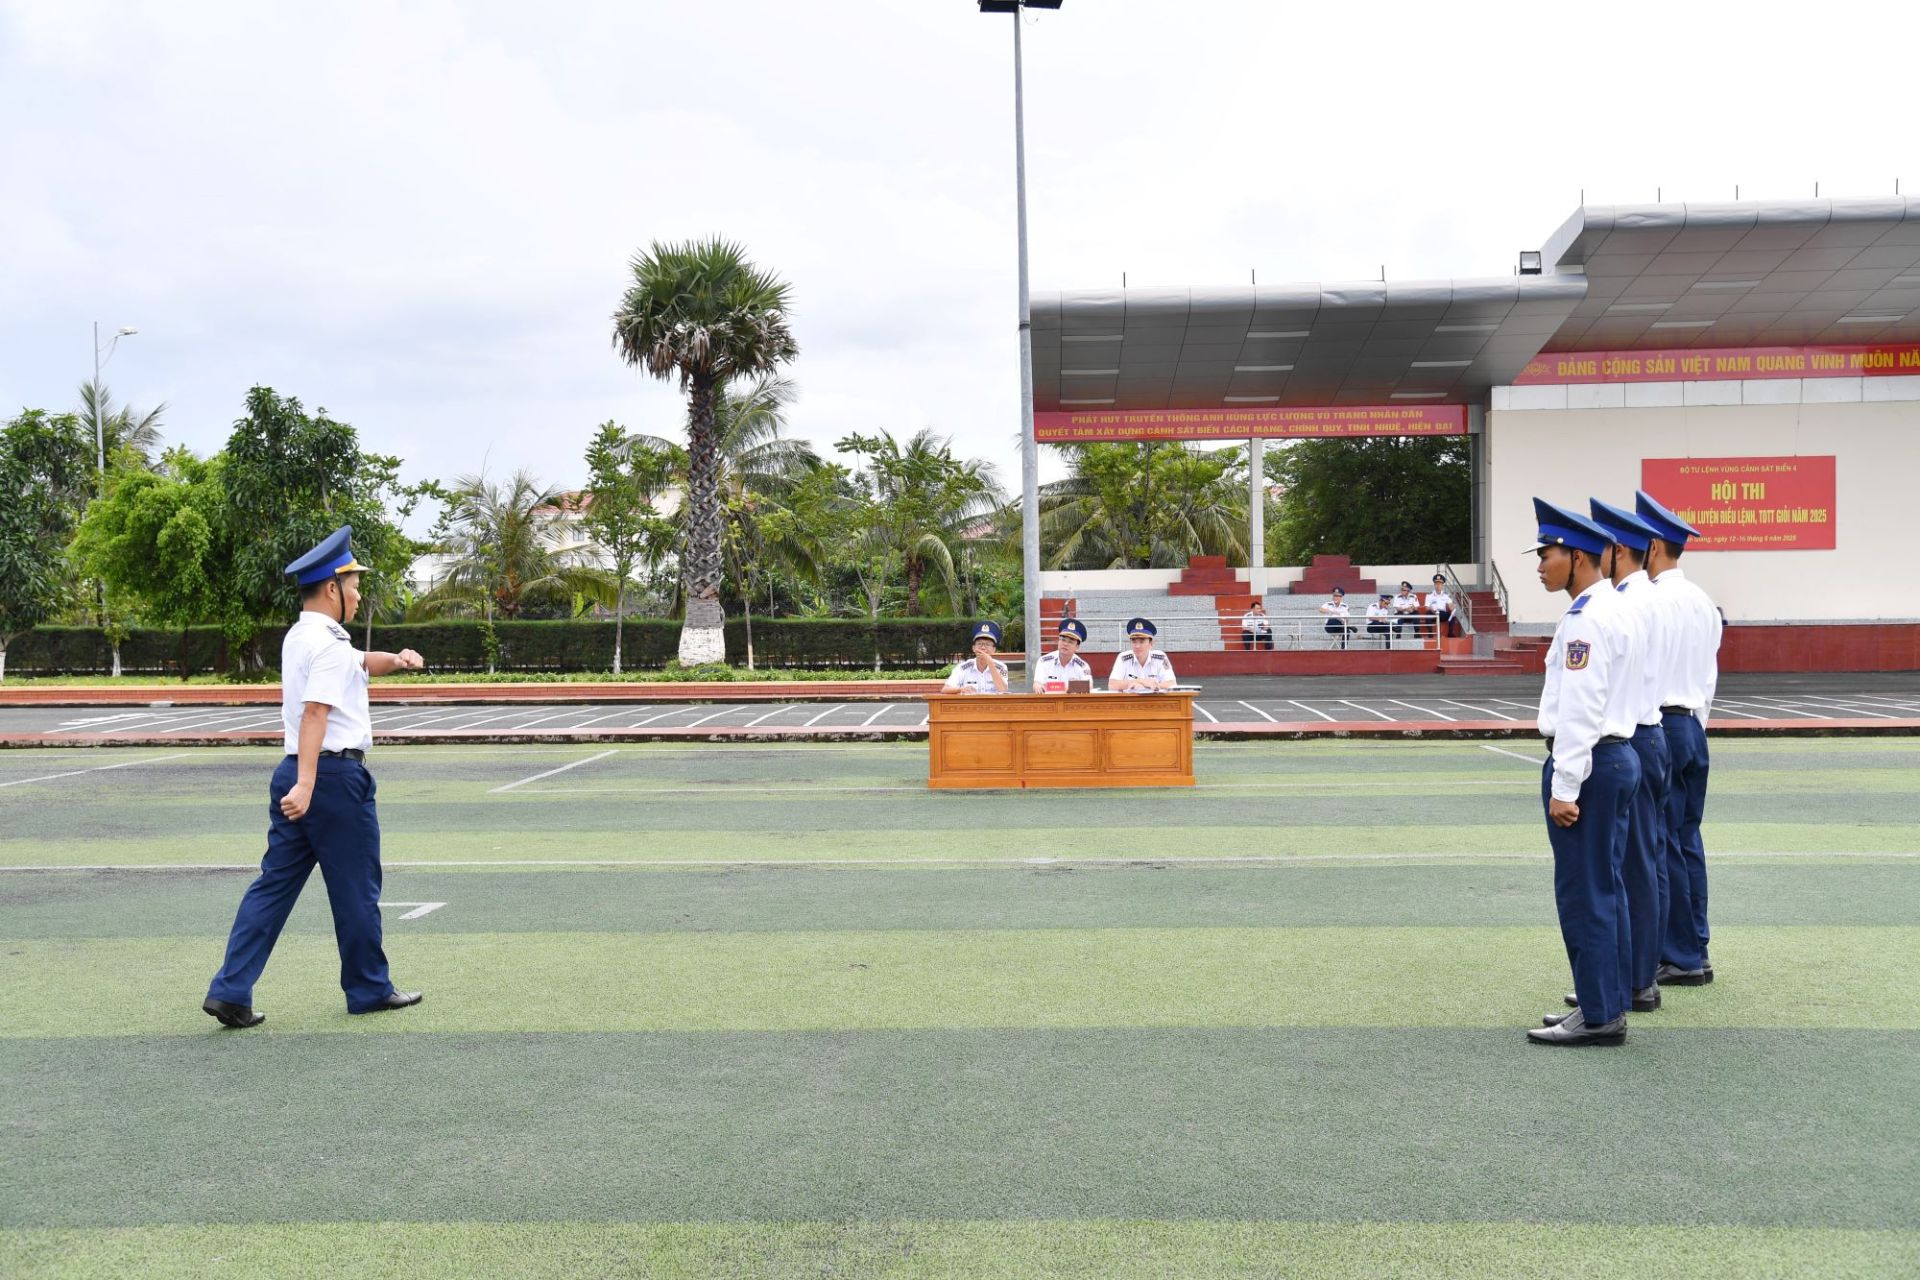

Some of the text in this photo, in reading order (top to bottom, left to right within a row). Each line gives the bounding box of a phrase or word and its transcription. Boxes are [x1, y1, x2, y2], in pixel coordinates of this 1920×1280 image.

[1557, 356, 1596, 377] ĐẢNG
[1602, 357, 1640, 377] CỘNG
[1645, 354, 1675, 374] SẢN
[1681, 356, 1711, 376] VIỆT
[1716, 356, 1751, 373] NAM
[1756, 354, 1805, 373] QUANG
[1811, 354, 1845, 369] VINH
[1850, 349, 1894, 369] MUÔN
[1101, 415, 1120, 423] HUY
[1203, 413, 1224, 421] ANH
[1334, 411, 1367, 419] TRANG
[1711, 479, 1765, 504] HỘI THI
[1791, 506, 1808, 523] NĂM
[1809, 508, 1827, 523] 2025
